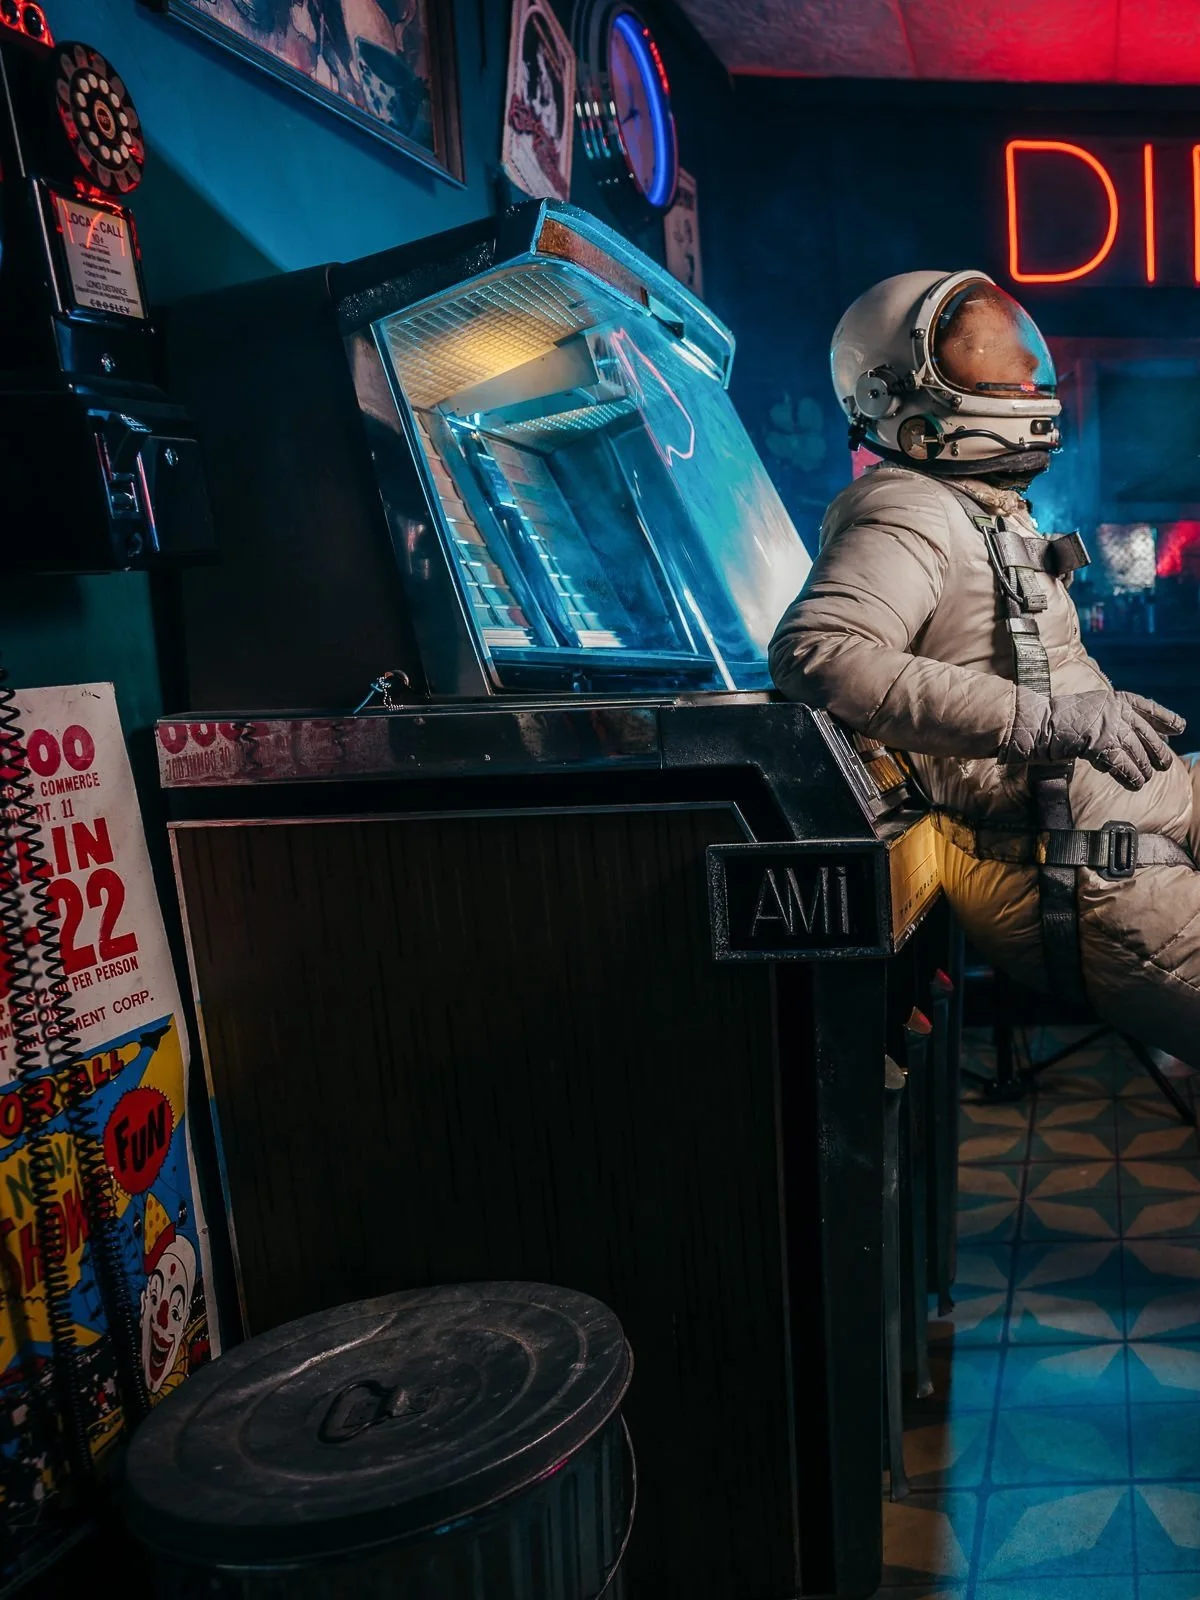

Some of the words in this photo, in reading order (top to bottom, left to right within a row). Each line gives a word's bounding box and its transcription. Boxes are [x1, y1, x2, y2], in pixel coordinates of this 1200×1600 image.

[99, 221, 124, 239] CALL
[40, 772, 101, 797] COMMERCE
[61, 798, 75, 819] 11
[72, 972, 94, 991] PER
[95, 955, 139, 983] PERSON
[112, 989, 155, 1015] CORP.
[113, 1100, 167, 1174] FUN
[5, 1137, 73, 1221] NW!
